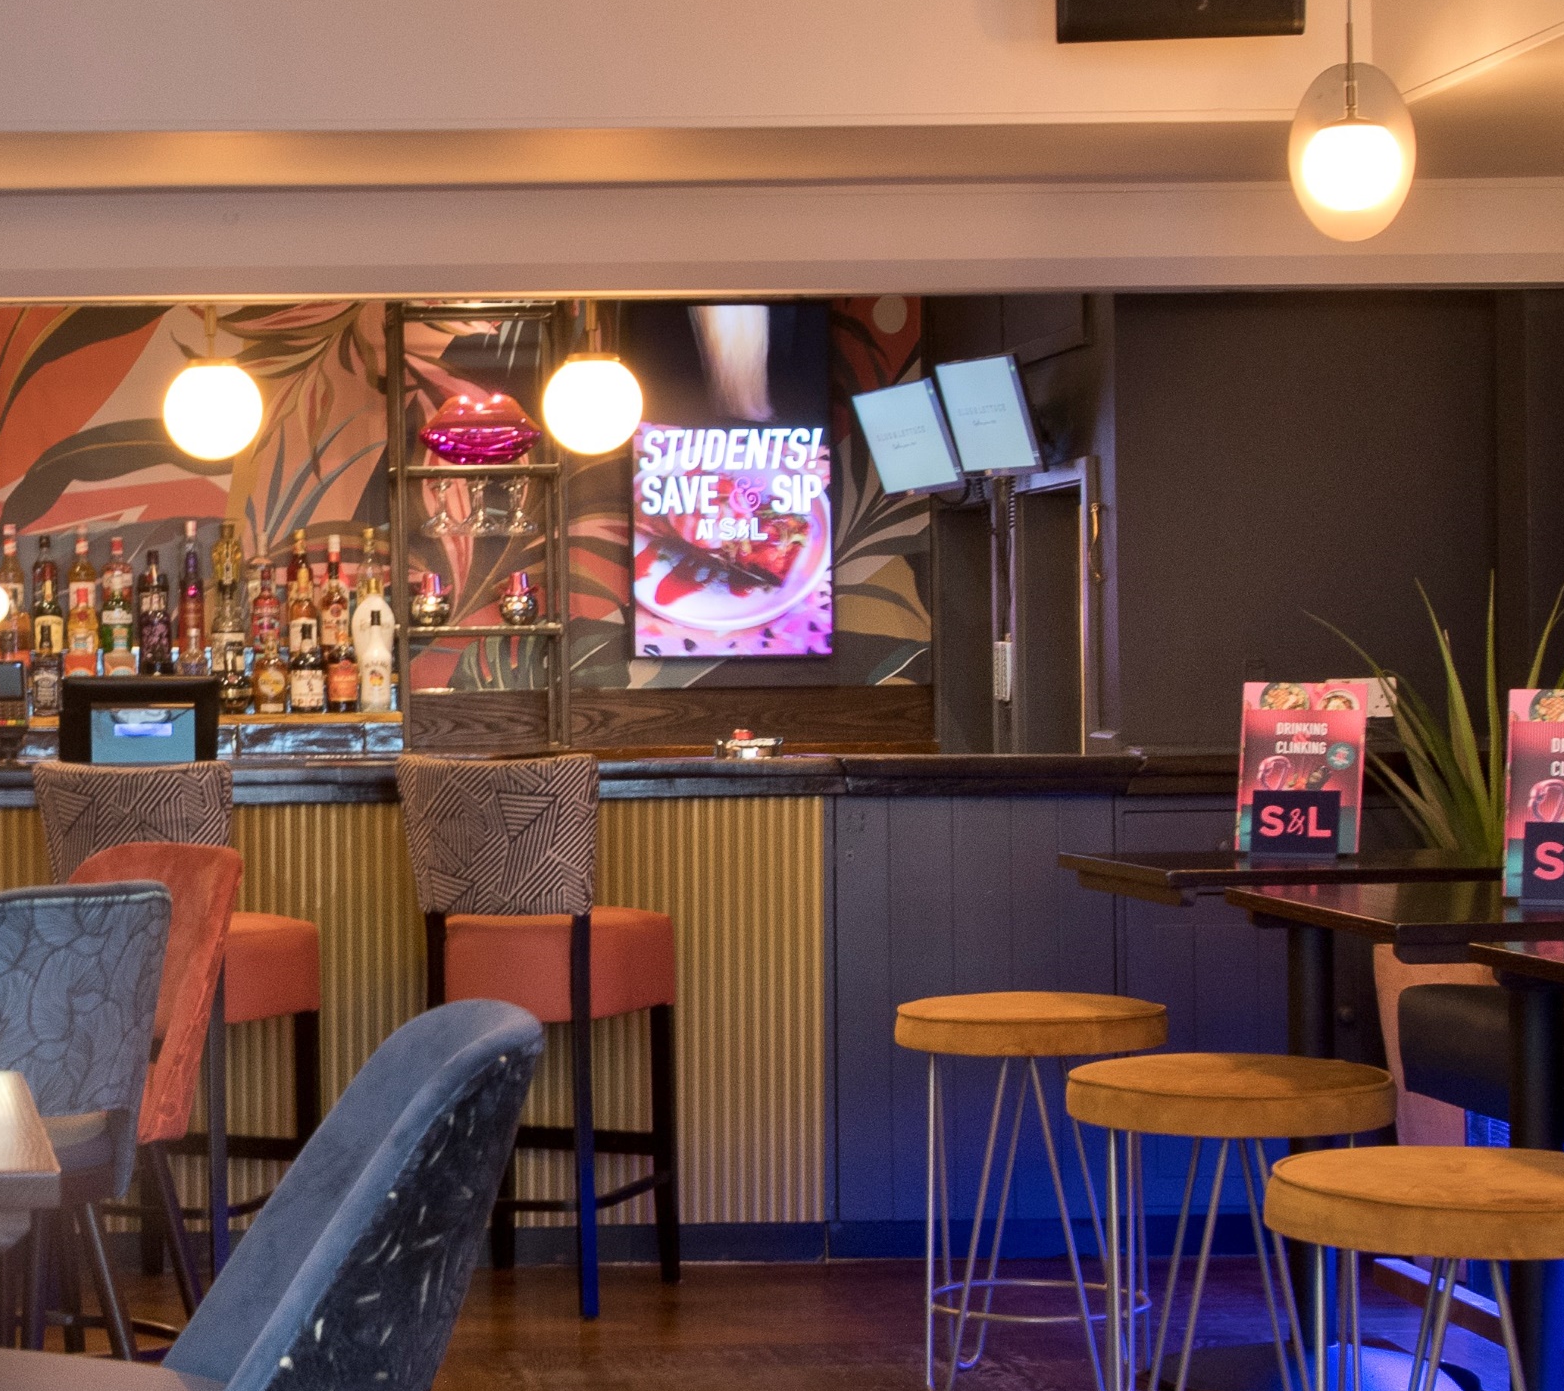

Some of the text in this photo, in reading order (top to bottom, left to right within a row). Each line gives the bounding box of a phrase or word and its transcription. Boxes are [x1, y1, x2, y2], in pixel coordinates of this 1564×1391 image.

[639, 427, 823, 471] STUDENTS!
[641, 474, 822, 515] SAVE & SIP
[695, 517, 768, 541] AT S&L
[1275, 722, 1328, 736] DRINKING
[1275, 740, 1327, 754] CLINKING
[1259, 805, 1332, 838] S&L
